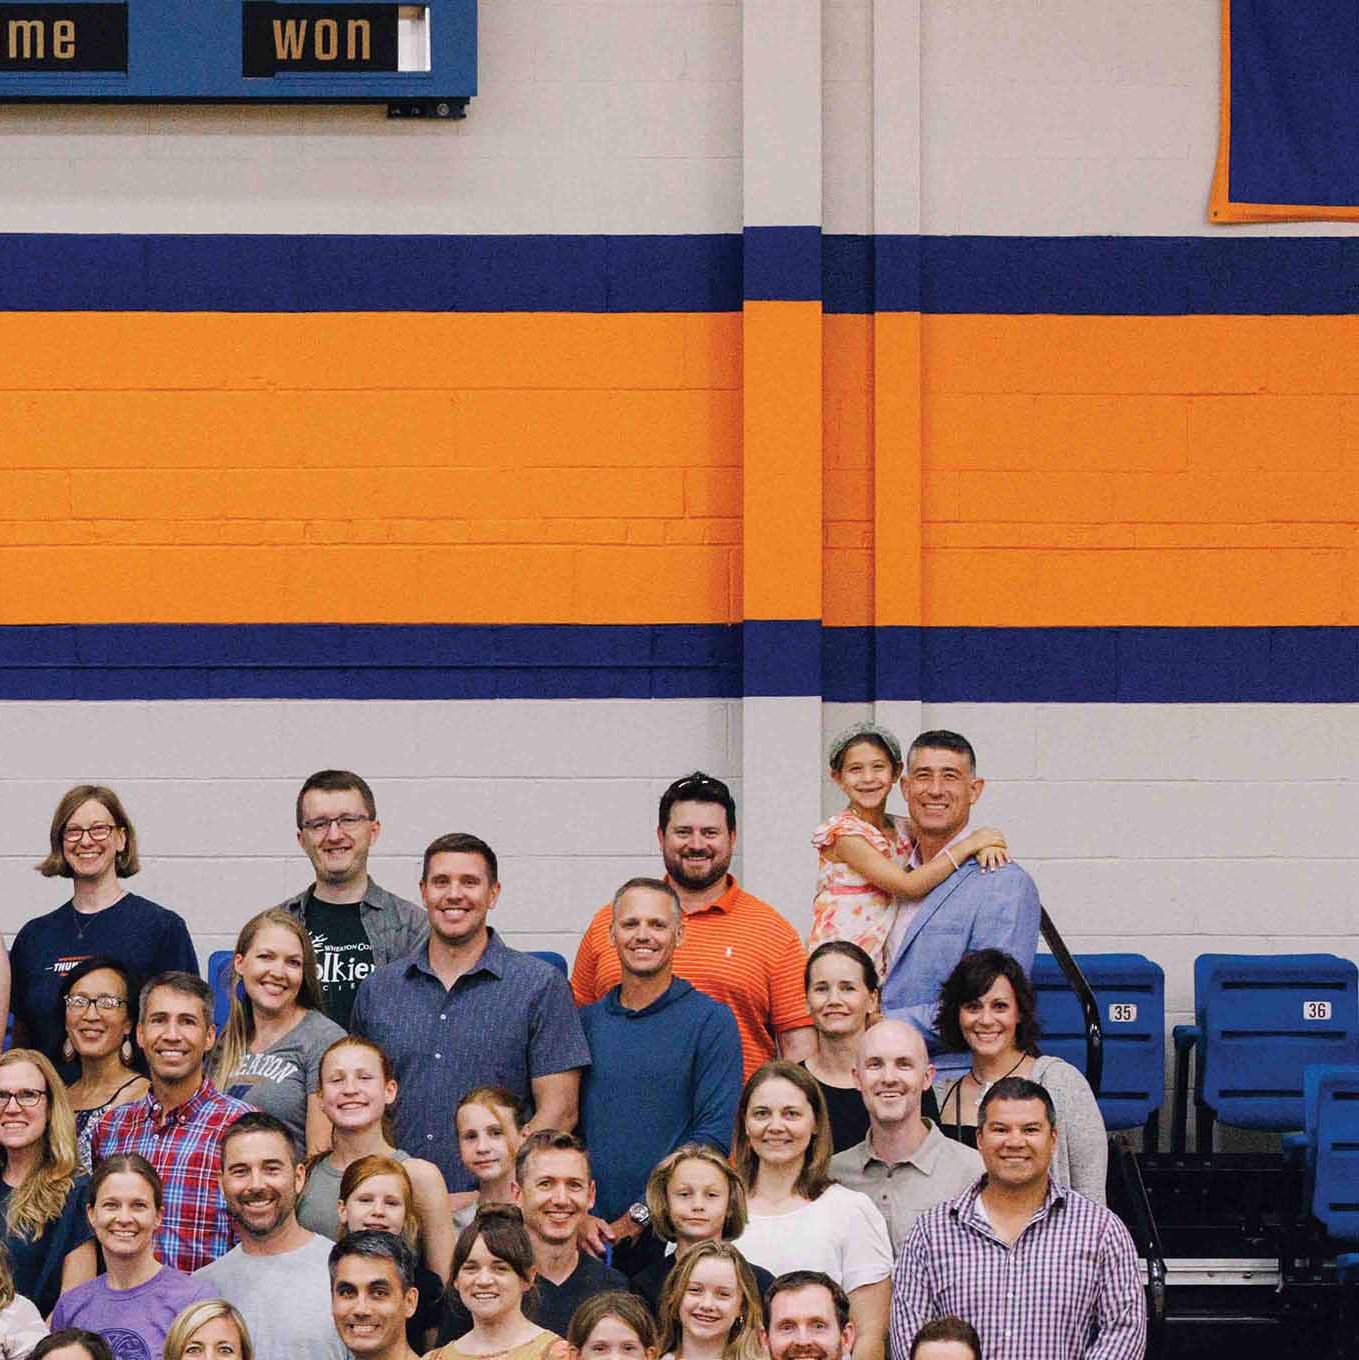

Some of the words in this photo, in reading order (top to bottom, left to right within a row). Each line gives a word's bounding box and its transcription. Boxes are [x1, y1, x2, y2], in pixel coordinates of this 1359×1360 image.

[272, 19, 371, 60] won
[1114, 1005, 1132, 1021] 35
[1308, 1003, 1327, 1019] 36
